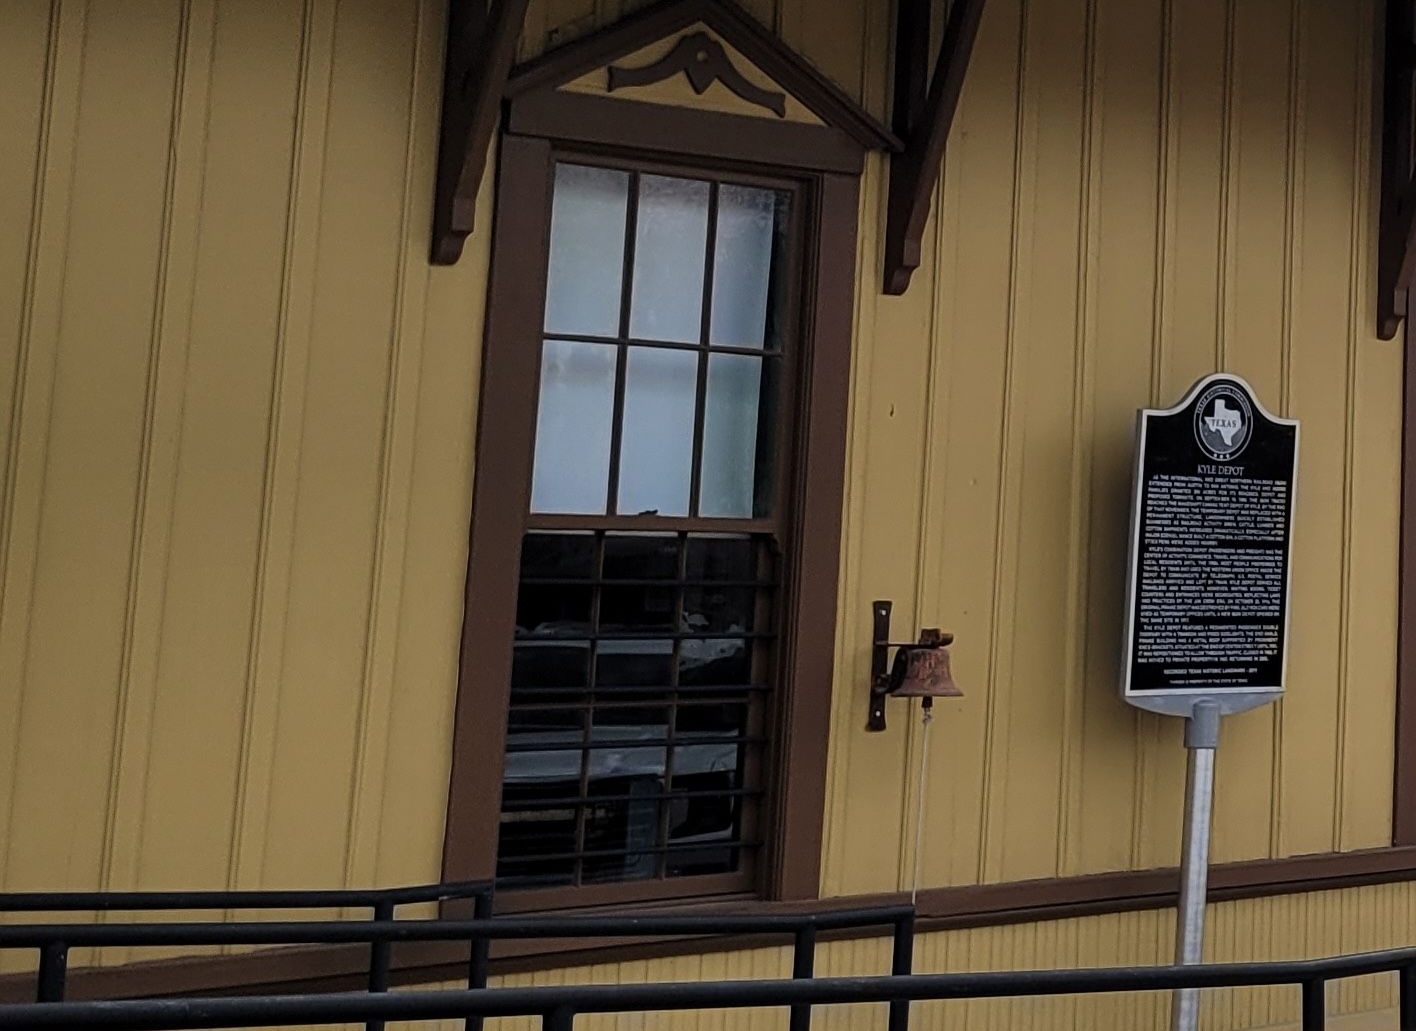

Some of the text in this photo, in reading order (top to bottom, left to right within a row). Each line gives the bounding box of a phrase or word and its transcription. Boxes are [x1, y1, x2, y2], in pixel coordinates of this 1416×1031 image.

[1212, 418, 1237, 428] TEXAS
[1197, 464, 1245, 477] KYLE DEPOT
